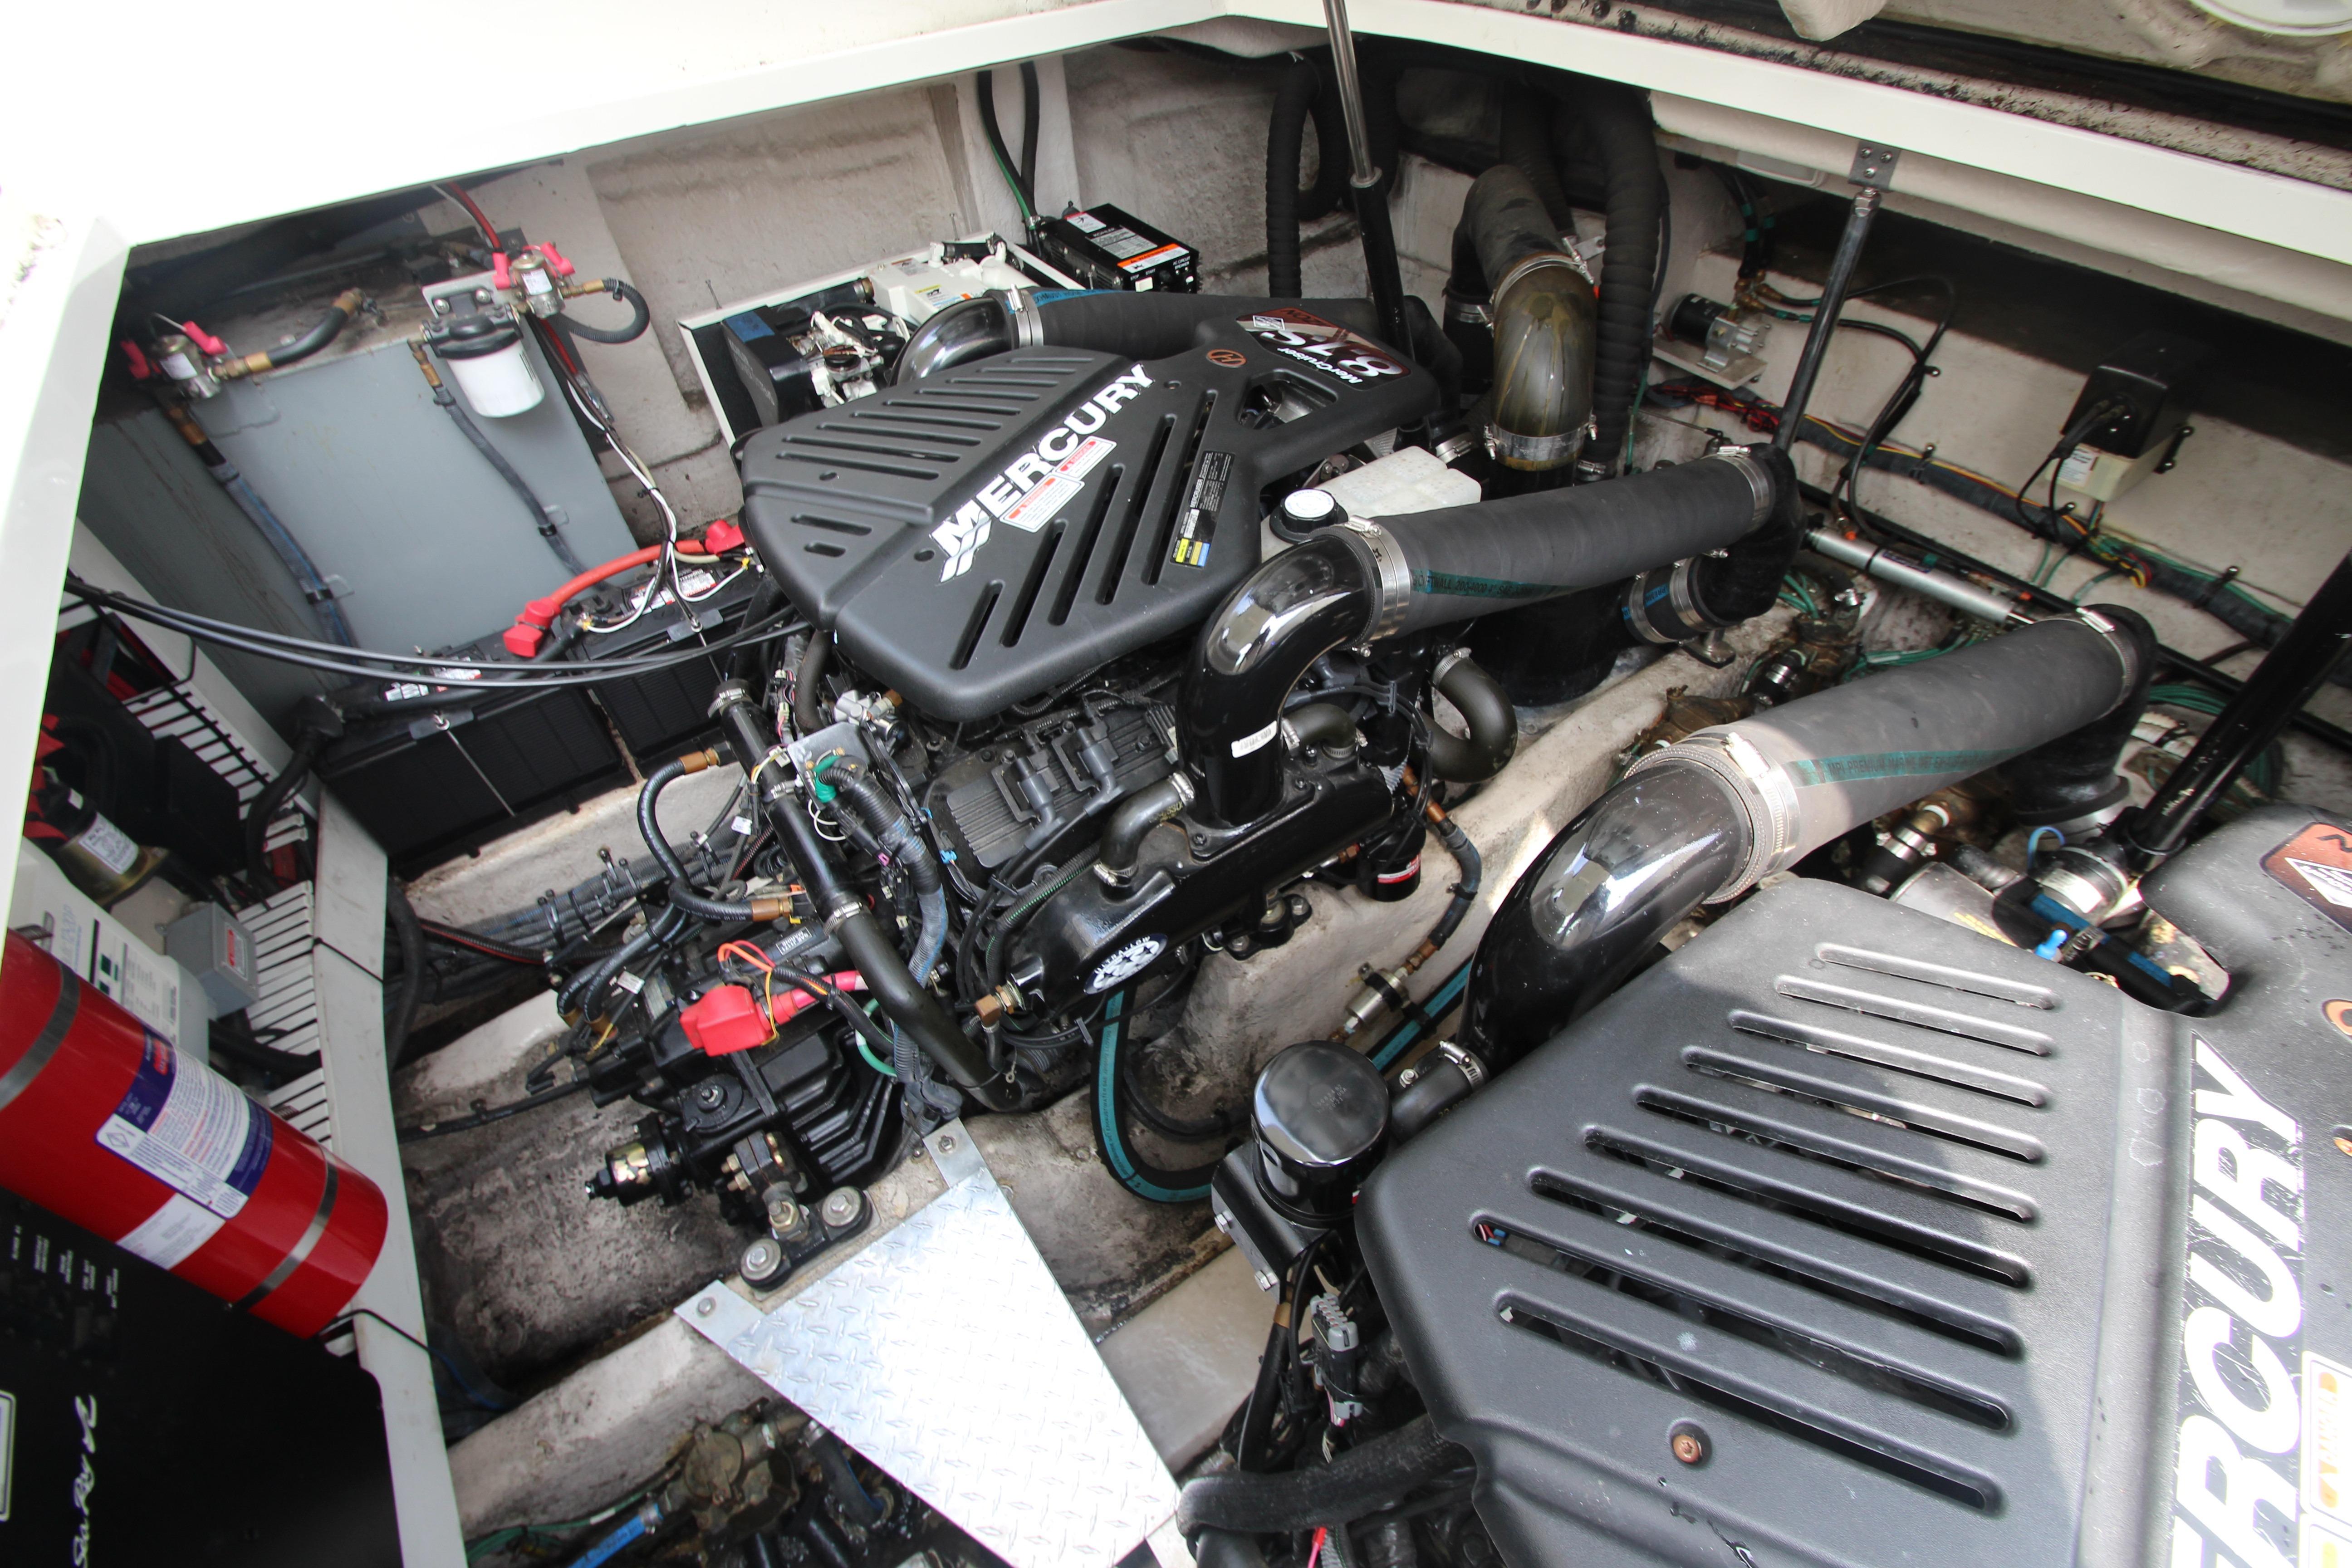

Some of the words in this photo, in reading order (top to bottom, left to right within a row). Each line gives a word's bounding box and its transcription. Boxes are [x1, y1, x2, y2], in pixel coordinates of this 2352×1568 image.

[930, 363, 1154, 565] MERCURY
[1278, 347, 1364, 385] MerCruiser
[2171, 1039, 2303, 1568] RCURY
